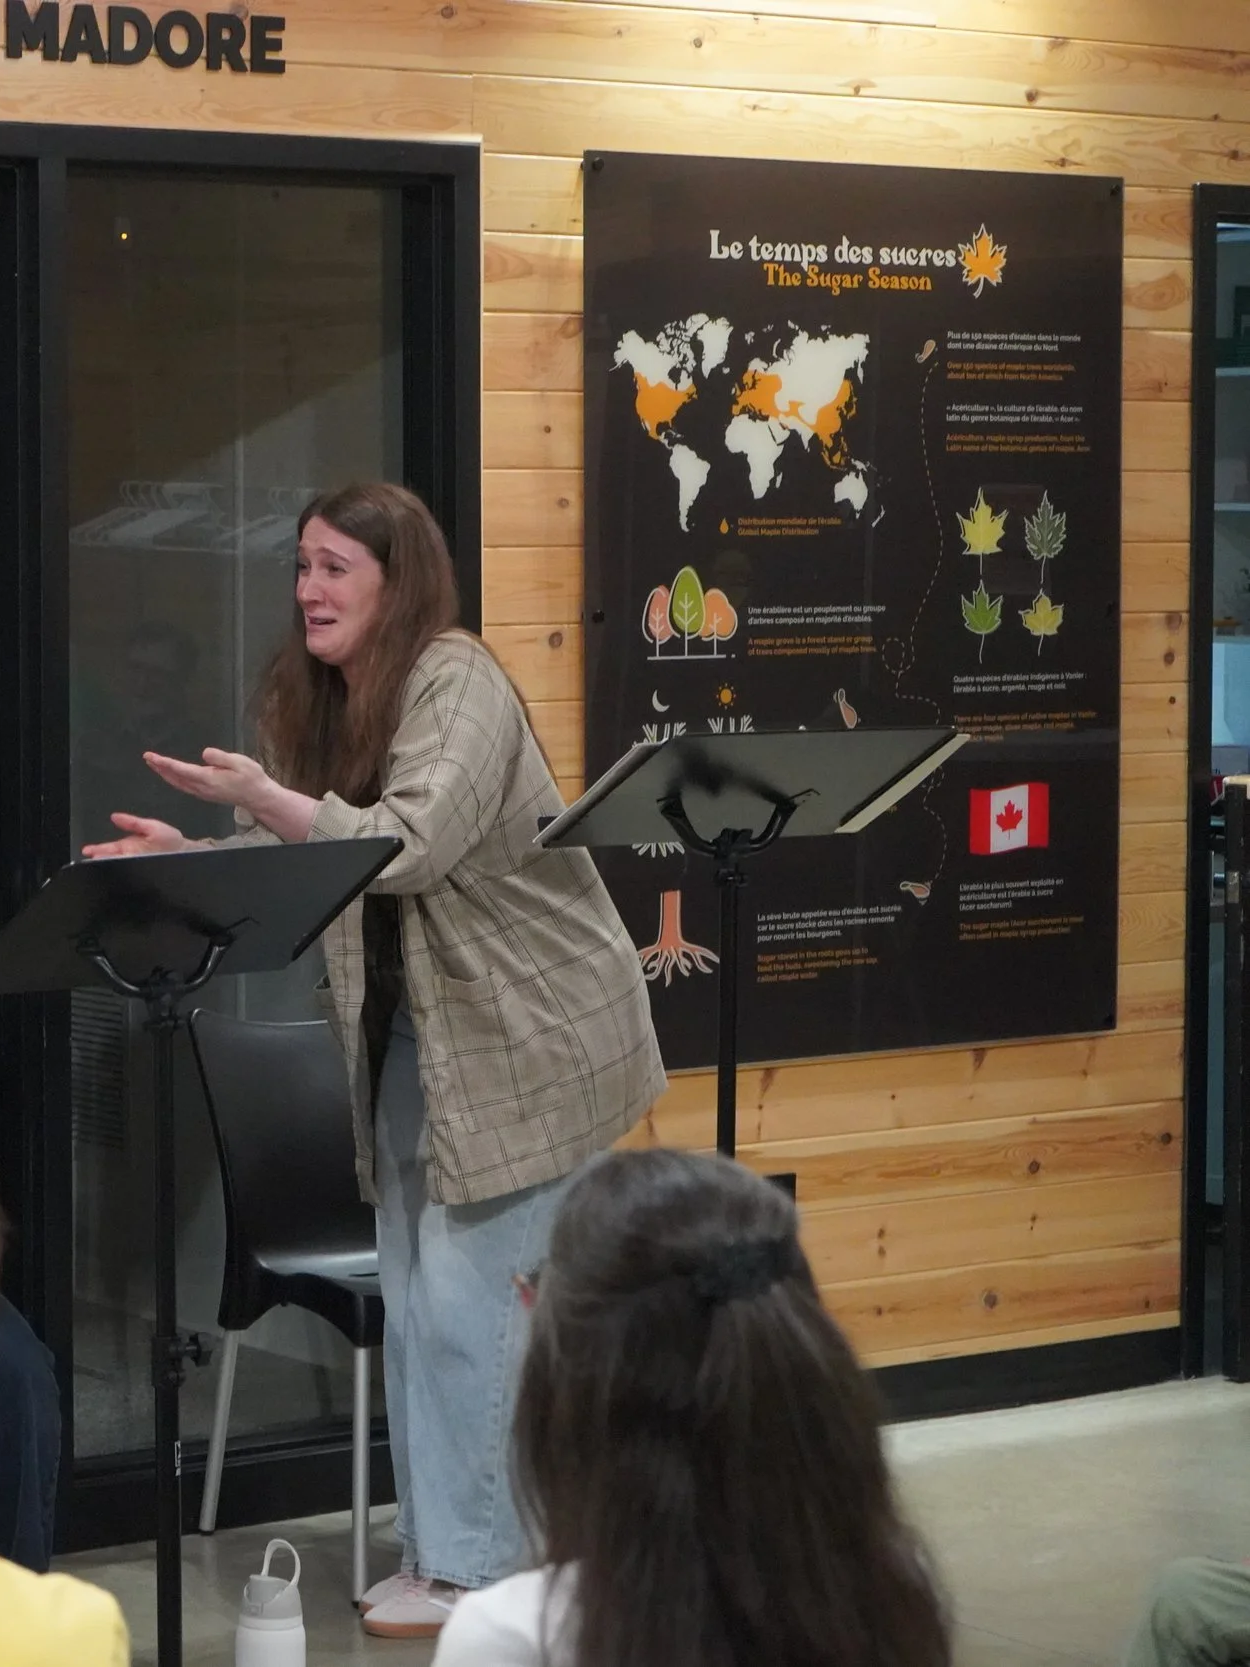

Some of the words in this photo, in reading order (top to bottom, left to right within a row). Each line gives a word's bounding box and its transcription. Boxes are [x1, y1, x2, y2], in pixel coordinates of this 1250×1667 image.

[5, 1, 286, 74] MADORE
[709, 229, 744, 260] Le
[748, 234, 829, 272] temps
[834, 235, 876, 266] des
[879, 245, 957, 268] sucres
[763, 262, 801, 287] The
[806, 264, 864, 296] Sugar
[868, 266, 933, 291] Season
[961, 332, 970, 340] de
